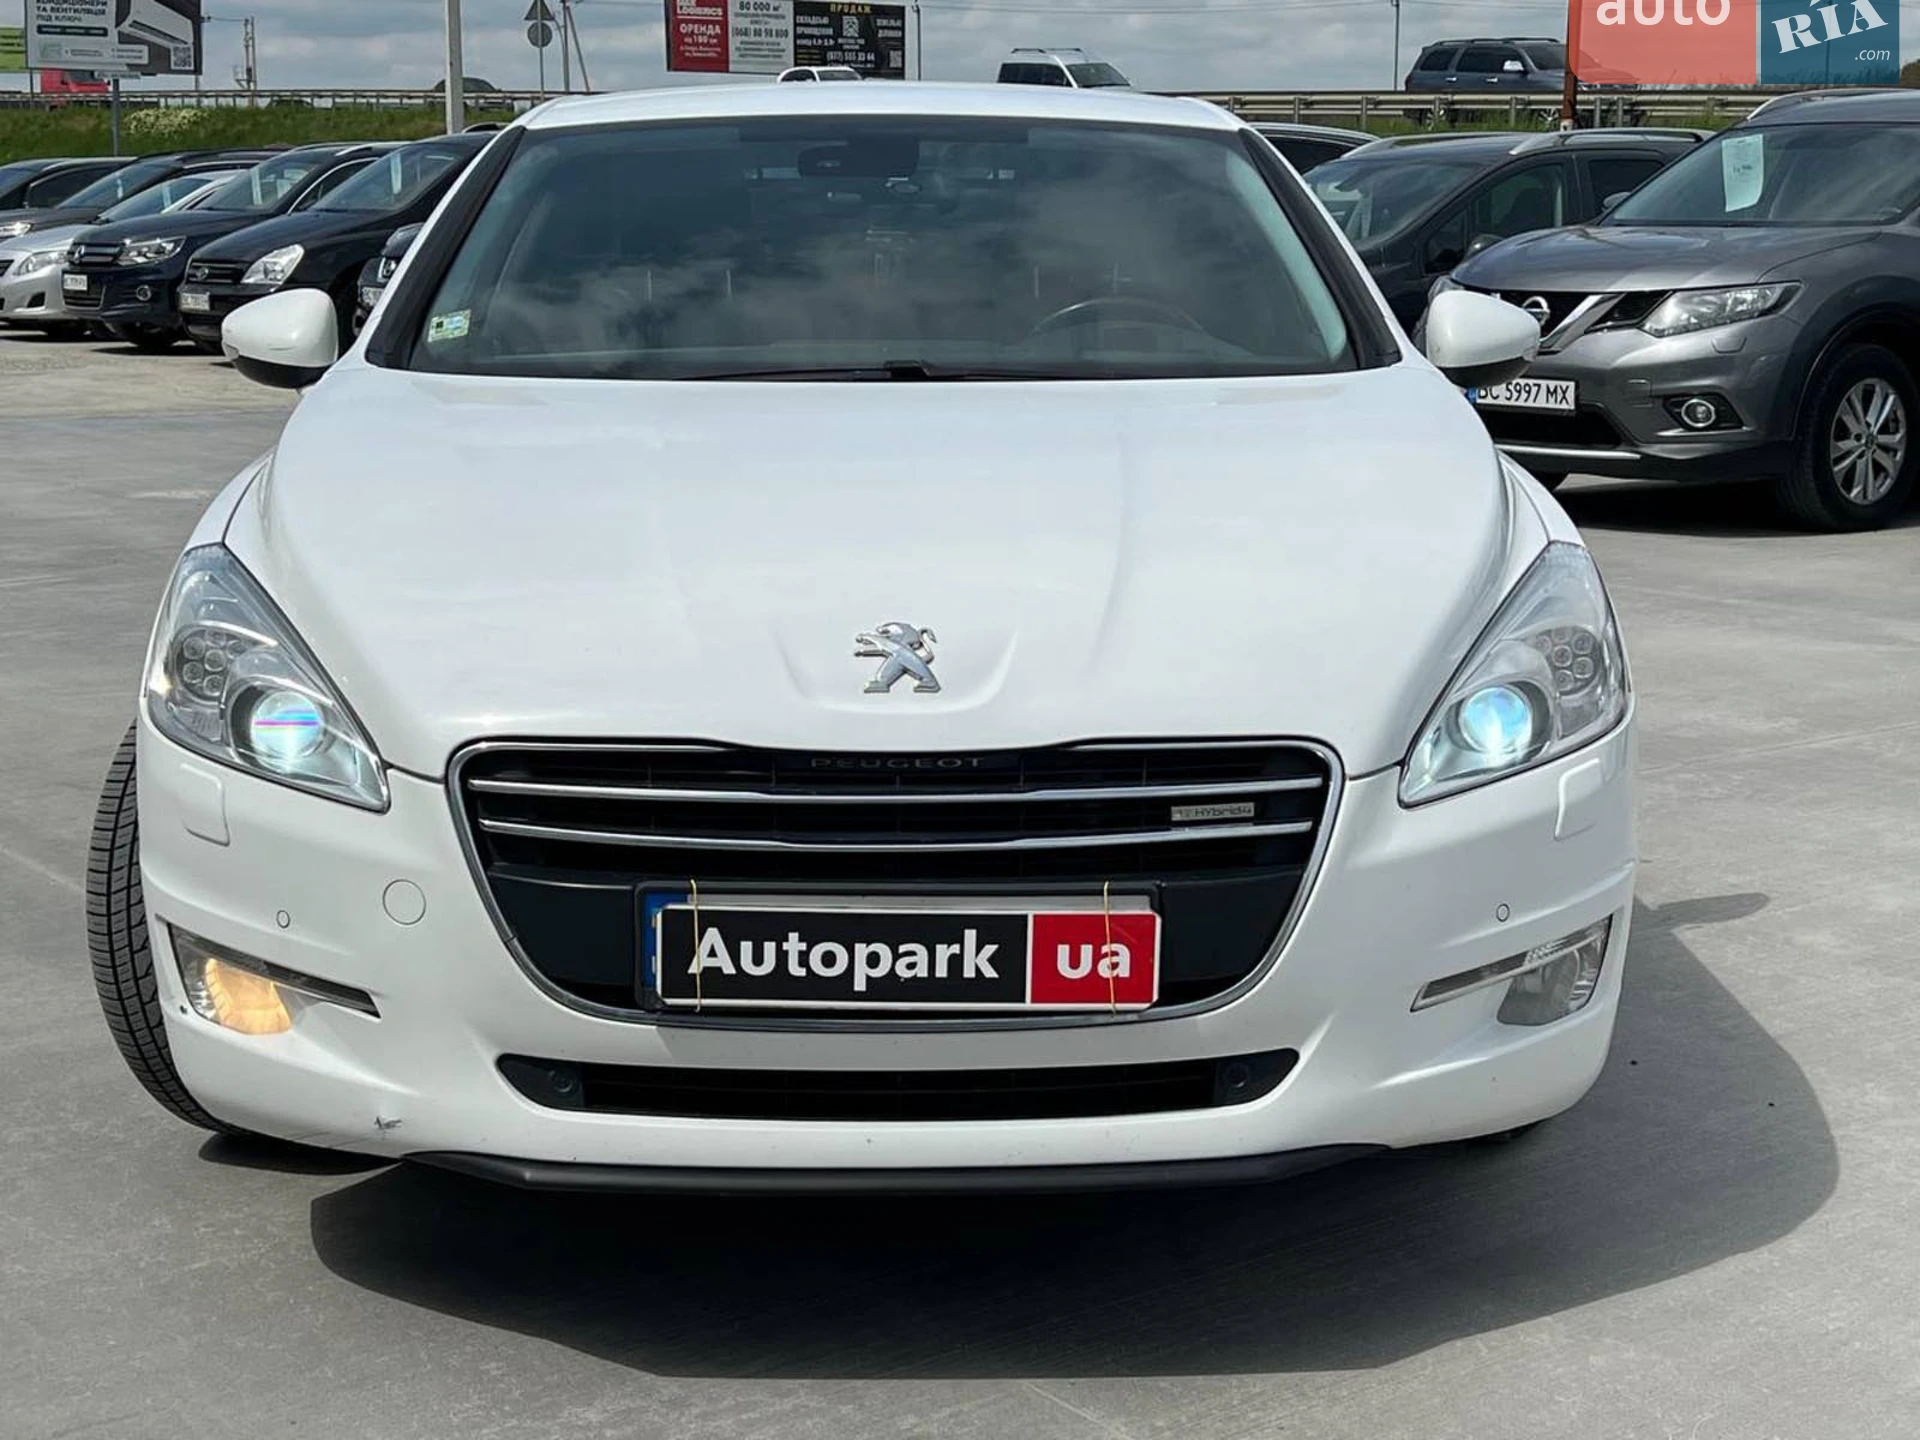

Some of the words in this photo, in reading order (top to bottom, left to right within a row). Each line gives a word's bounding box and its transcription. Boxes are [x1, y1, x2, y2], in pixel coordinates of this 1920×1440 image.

[753, 2, 770, 11] 000
[830, 4, 871, 14] ПРОДАЖ
[680, 23, 720, 36] ОРЕНДА
[1504, 382, 1541, 403] 5997
[1546, 384, 1570, 406] MX
[810, 757, 984, 769] PEUGEOT
[687, 926, 1000, 992] Autopark
[1056, 941, 1132, 978] ua
